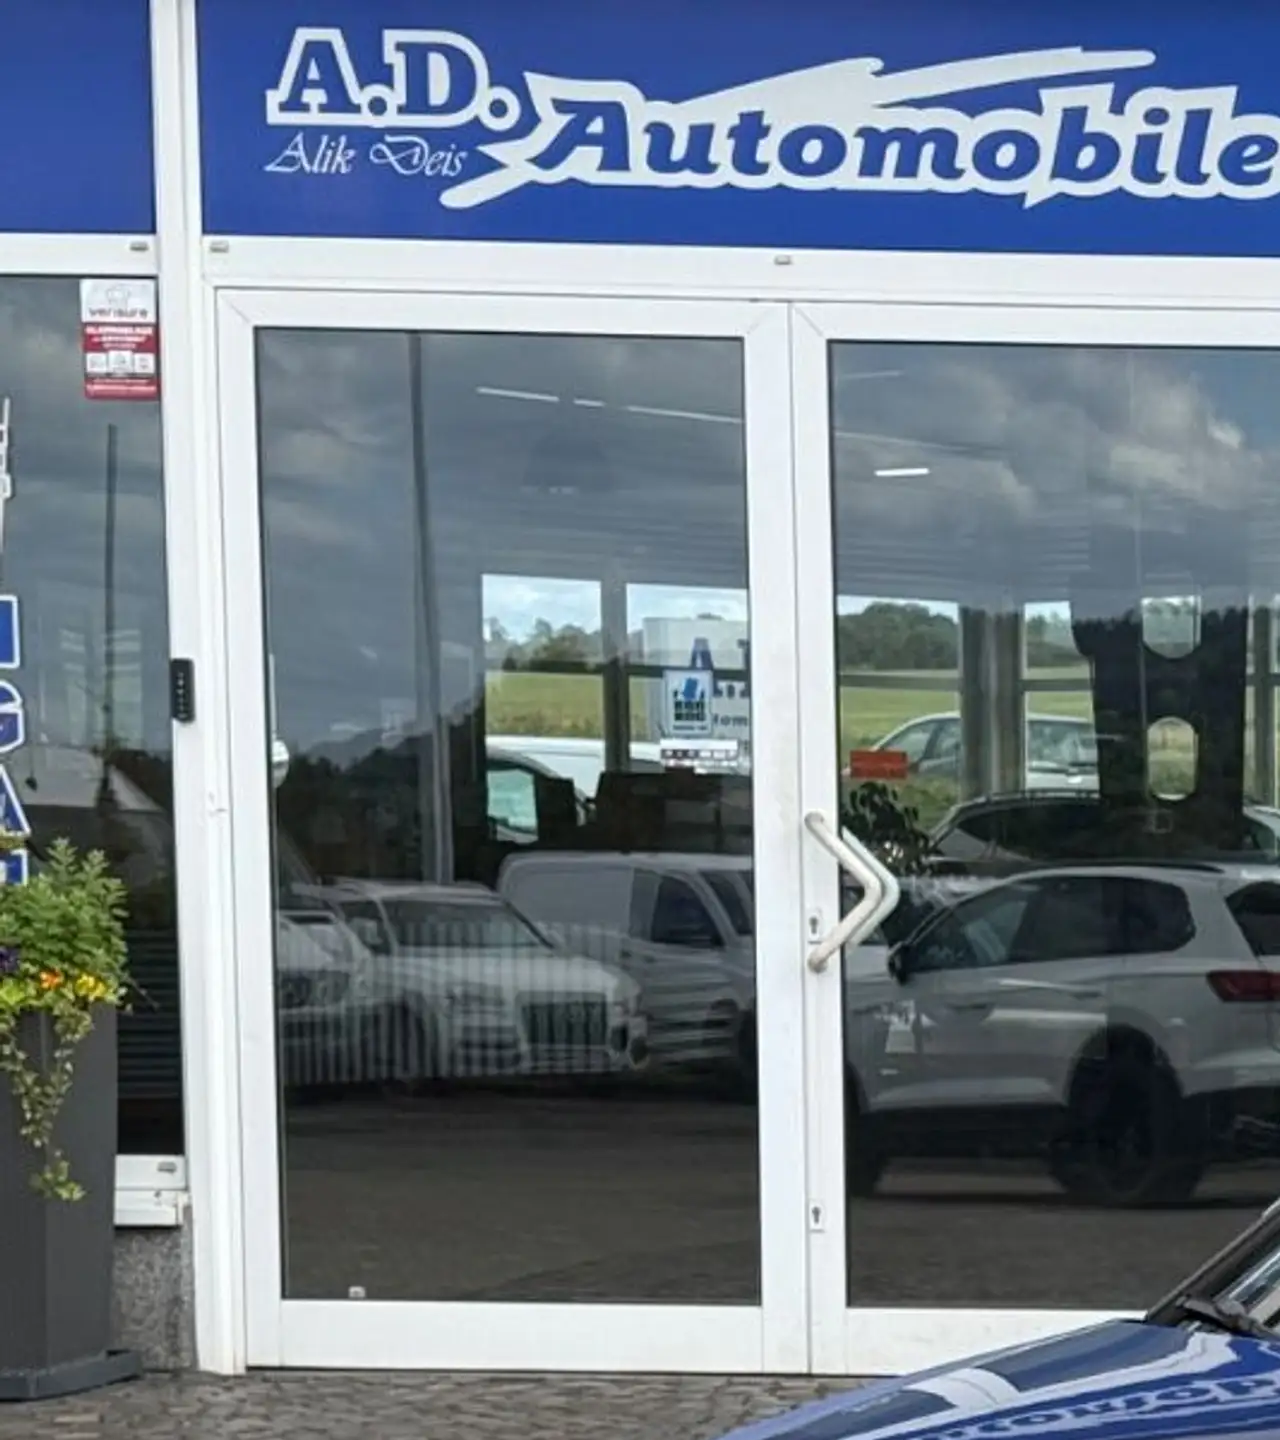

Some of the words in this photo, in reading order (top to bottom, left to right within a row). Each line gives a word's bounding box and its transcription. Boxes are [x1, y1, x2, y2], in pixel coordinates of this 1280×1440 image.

[266, 27, 520, 132] A.D.
[264, 133, 353, 176] Alik
[369, 135, 467, 176] Deis
